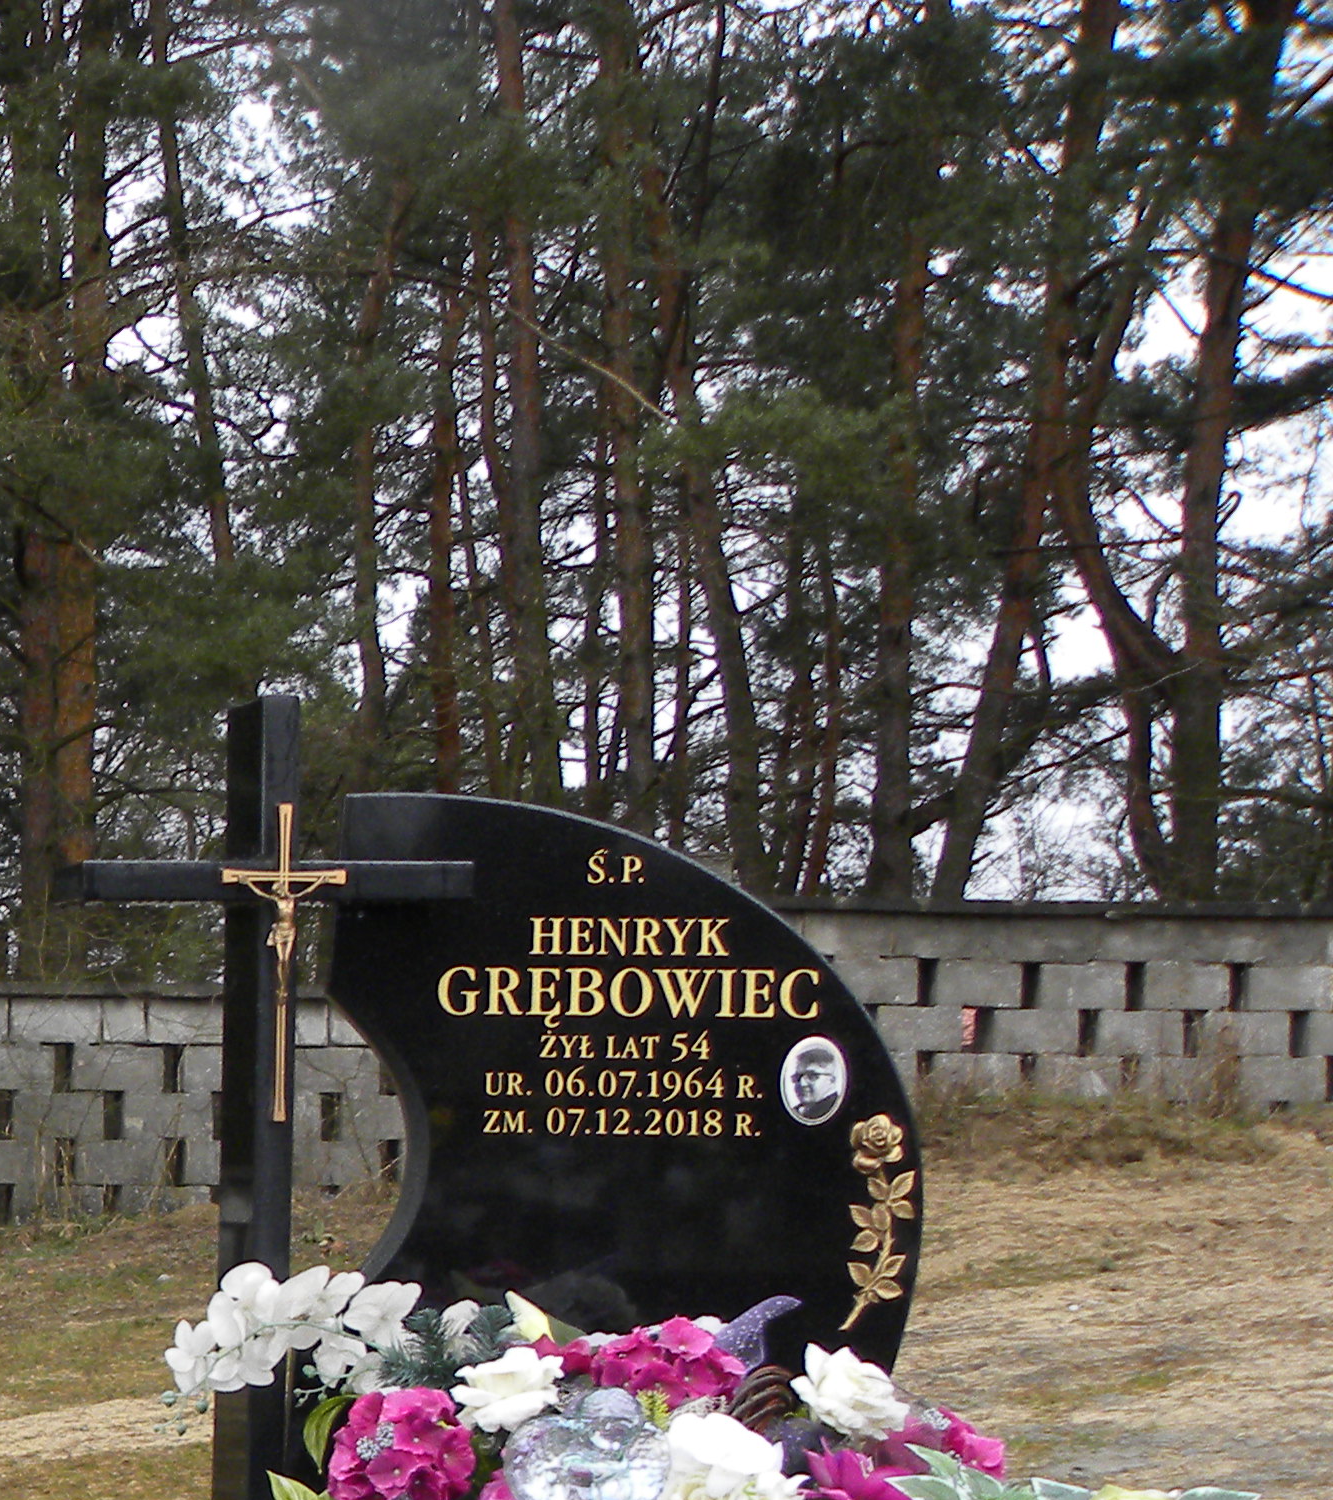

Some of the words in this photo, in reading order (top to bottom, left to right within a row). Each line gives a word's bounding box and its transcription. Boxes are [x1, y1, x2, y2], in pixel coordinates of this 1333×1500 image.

[528, 917, 730, 957] HENRYK
[437, 966, 820, 1028] GRĘBOWIEC
[540, 1031, 595, 1060] ŻYŁ
[606, 1036, 660, 1060] LAT
[671, 1031, 710, 1062] 54
[485, 1072, 532, 1097] UR.
[544, 1067, 725, 1103] 06.07.1964
[737, 1074, 763, 1099] R.
[482, 1110, 533, 1135] ZM.
[546, 1107, 723, 1138] 07.12.2018
[735, 1113, 761, 1138] R.
